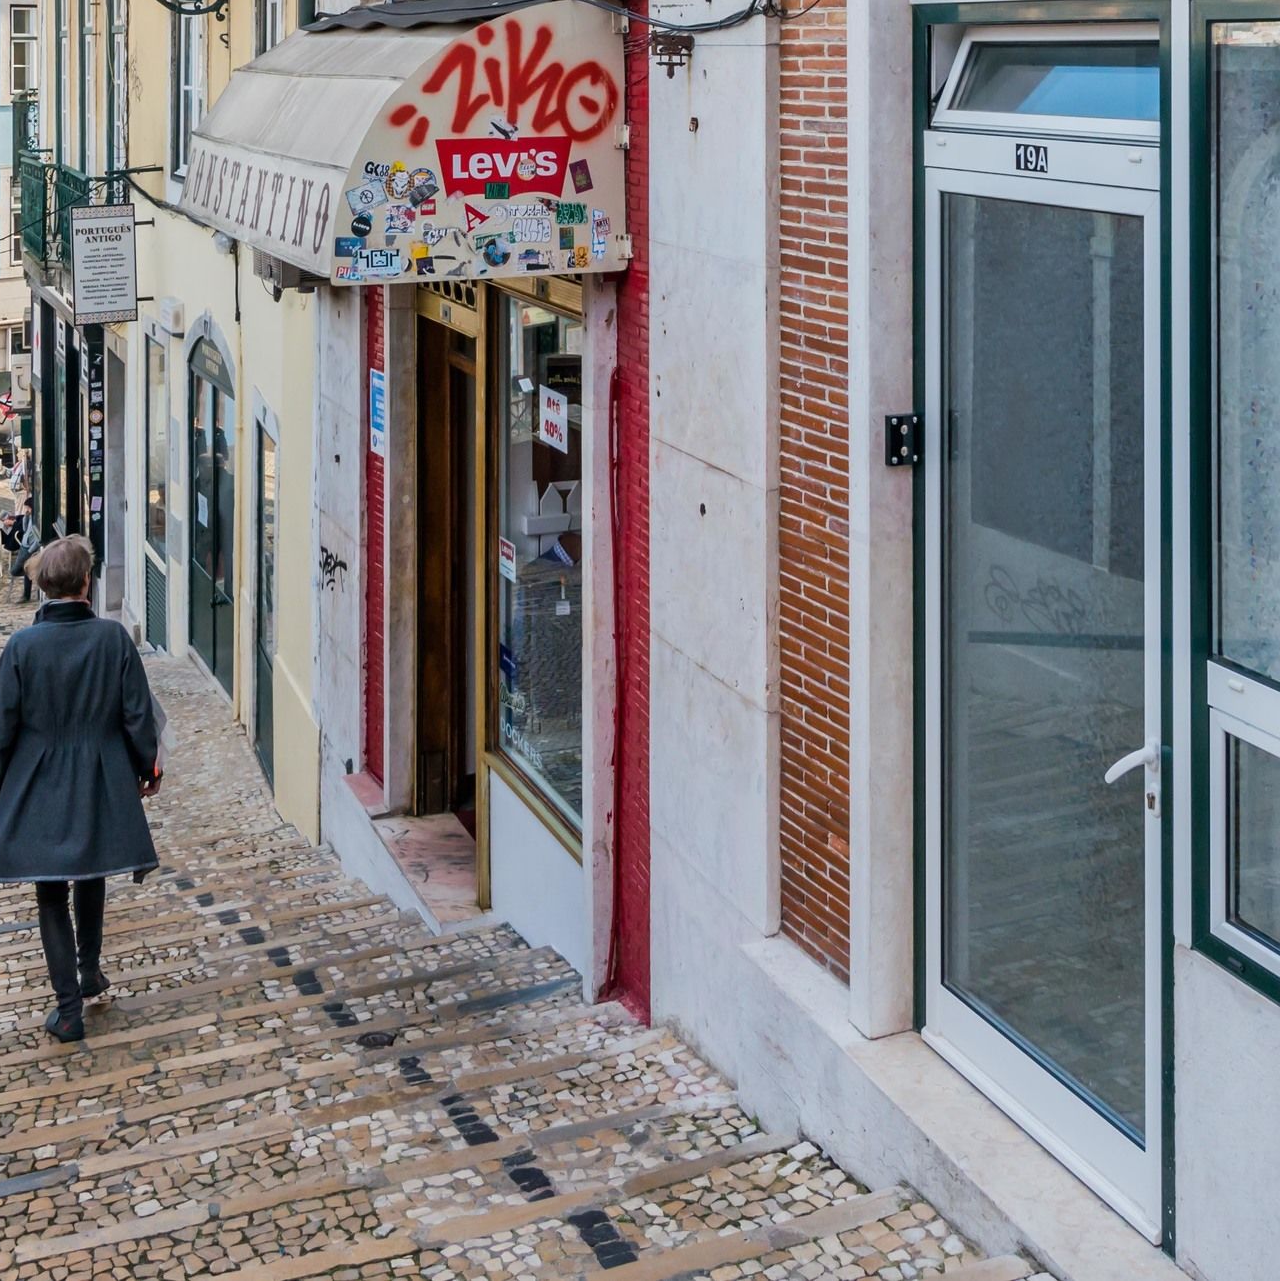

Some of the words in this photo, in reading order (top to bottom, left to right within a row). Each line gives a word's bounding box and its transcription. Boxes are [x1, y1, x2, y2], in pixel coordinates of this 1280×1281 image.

[1017, 145, 1047, 172] 19A
[183, 148, 330, 255] CONSTANTINO
[75, 223, 131, 237] PORTUGUÊS
[84, 234, 122, 244] ANTIGO
[546, 396, 561, 416] Até
[544, 419, 563, 444] 40%
[500, 716, 543, 770] DOCKERS
